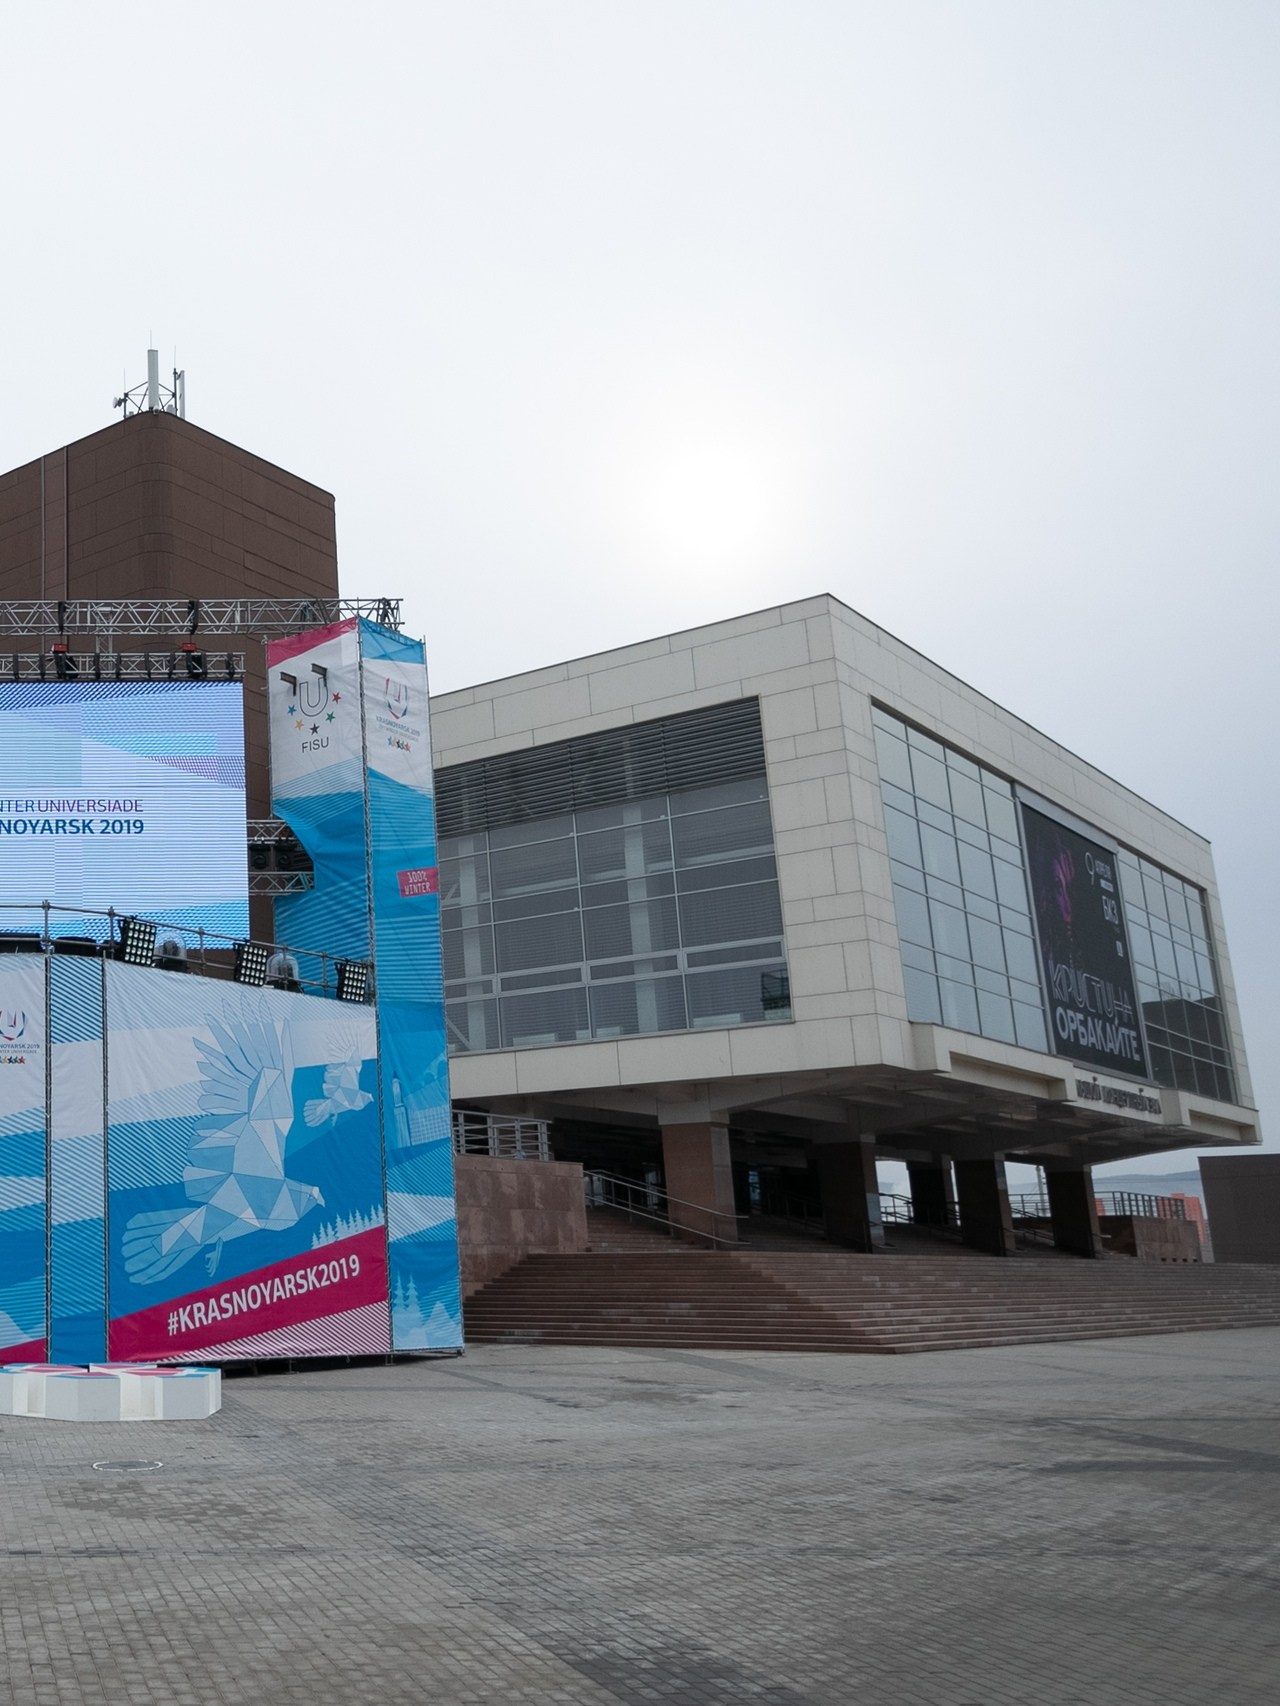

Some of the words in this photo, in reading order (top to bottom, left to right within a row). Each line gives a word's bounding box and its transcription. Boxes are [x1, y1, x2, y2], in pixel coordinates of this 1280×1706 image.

[301, 736, 330, 753] FISU
[37, 799, 144, 813] UNIVERSIADE
[99, 818, 144, 835] 2019
[407, 870, 428, 883] 100%
[404, 881, 431, 895] WINTER
[167, 1254, 360, 1337] #KRASNOYARSK2019
